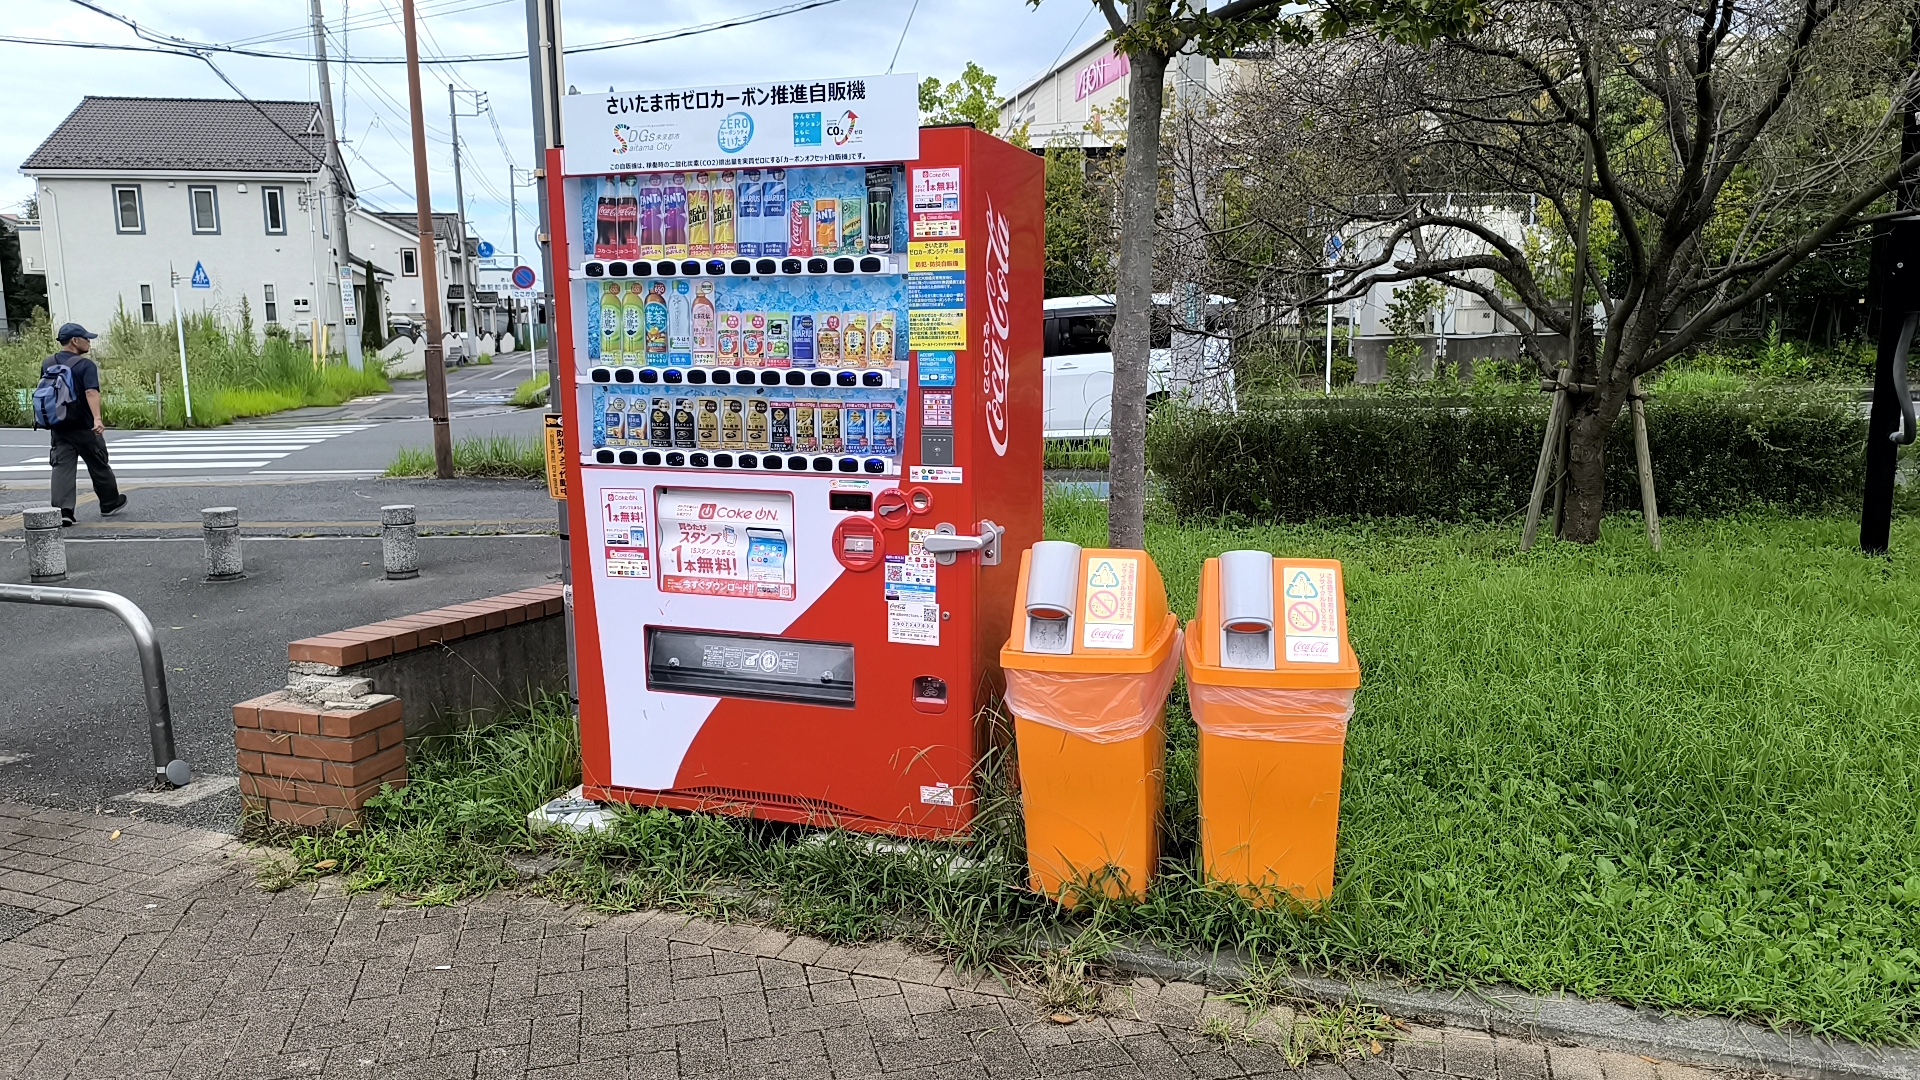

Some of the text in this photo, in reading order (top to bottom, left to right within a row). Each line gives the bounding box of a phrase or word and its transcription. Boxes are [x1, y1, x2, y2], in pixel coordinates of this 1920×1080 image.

[606, 80, 866, 115] さいたま市ゼロカーボン推進自販機
[719, 118, 748, 130] ZERO
[656, 142, 673, 152] City
[720, 136, 749, 147] さいたま
[717, 507, 752, 519] Coke
[678, 522, 707, 531] 買うたび
[680, 532, 722, 545] スタンプ
[690, 548, 736, 556] 15スタンプたまると
[671, 544, 738, 576] 1本無料!
